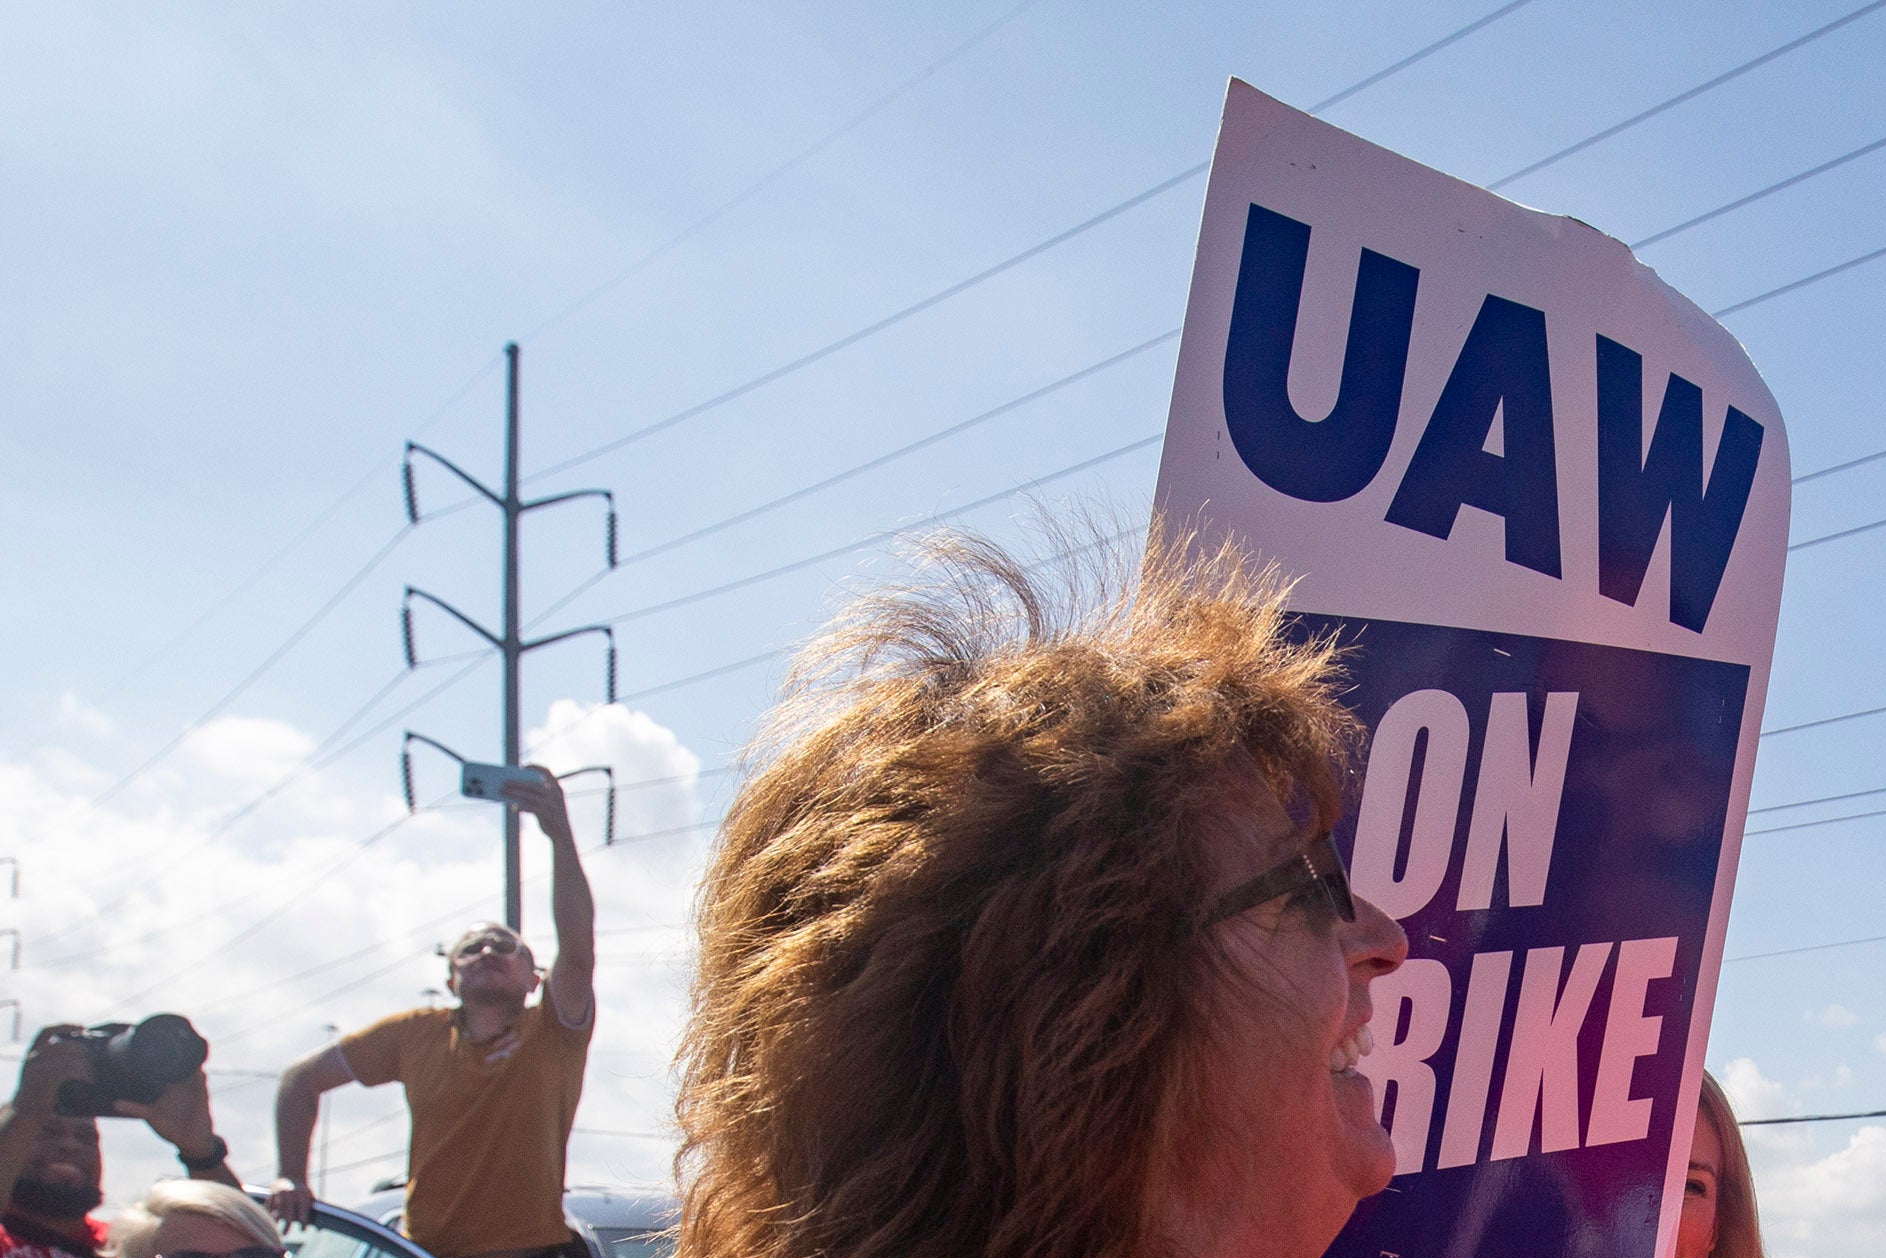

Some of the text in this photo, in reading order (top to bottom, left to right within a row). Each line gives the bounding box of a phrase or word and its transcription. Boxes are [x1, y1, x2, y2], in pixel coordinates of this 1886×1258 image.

[1222, 201, 1765, 635] UAW
[1350, 688, 1580, 920] ON
[1369, 936, 1679, 1177] RIKE
